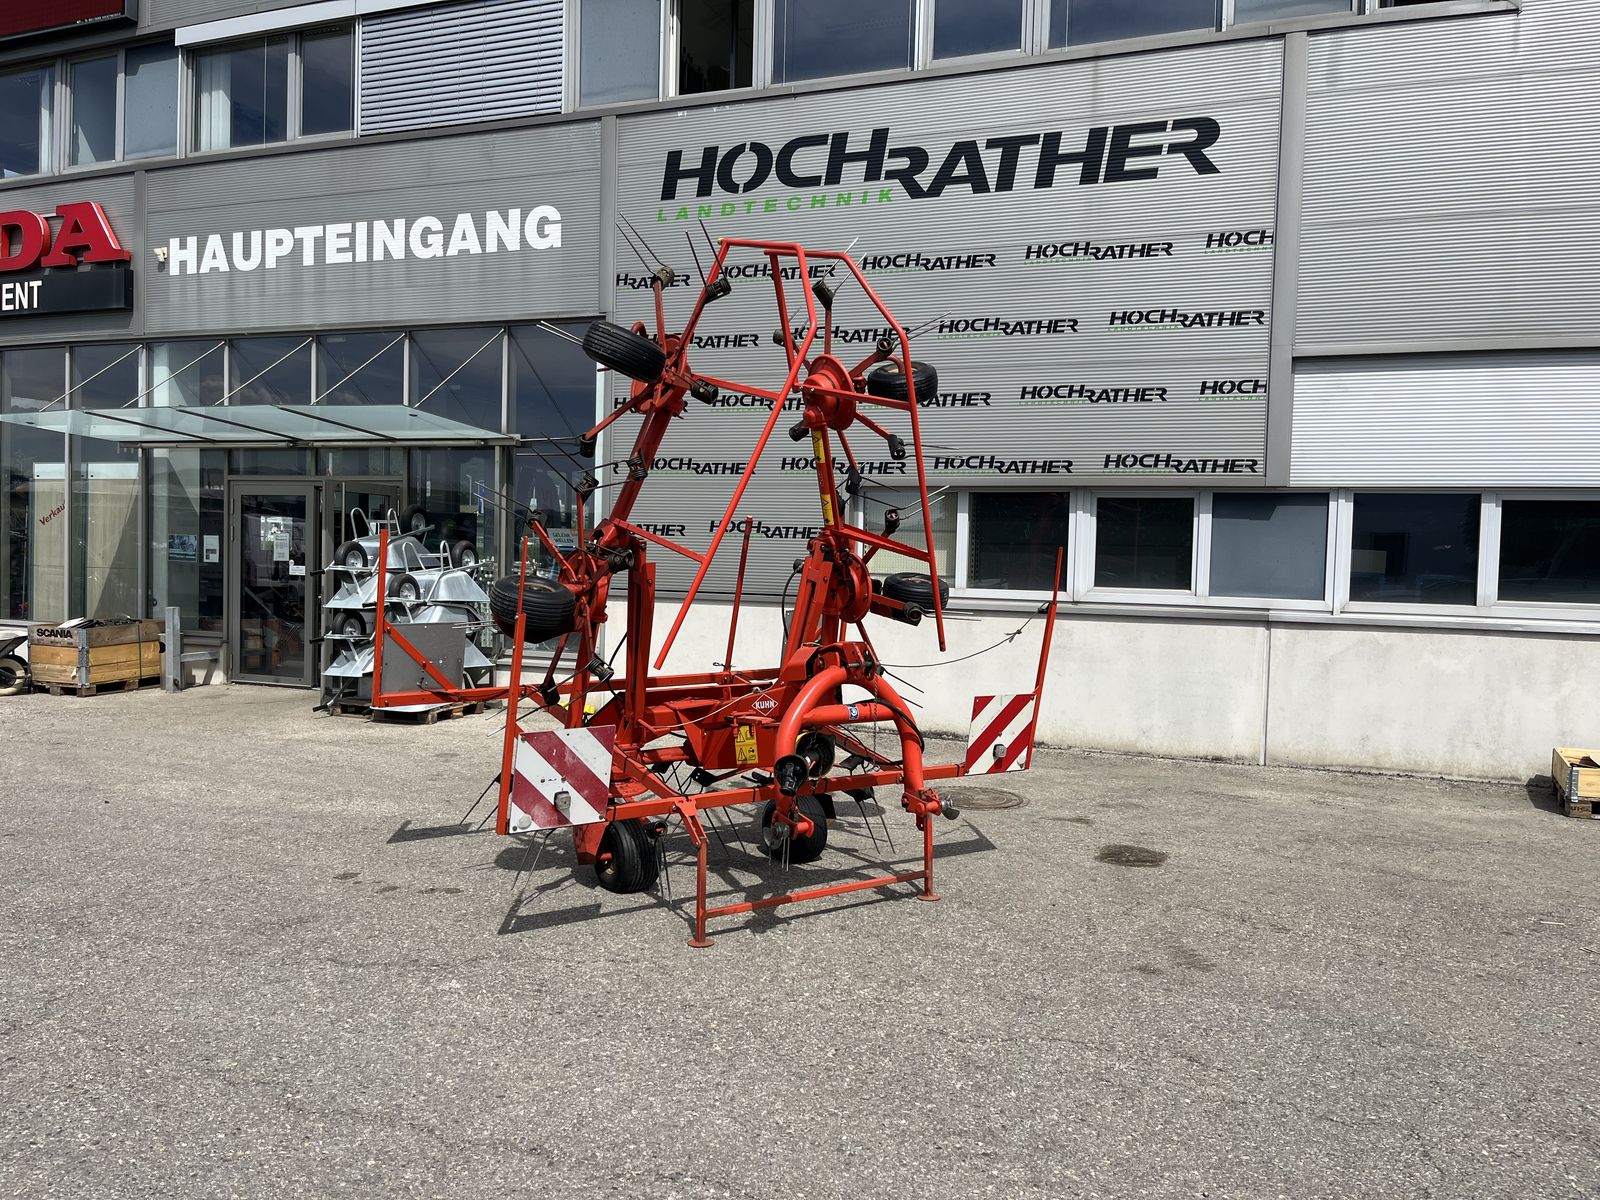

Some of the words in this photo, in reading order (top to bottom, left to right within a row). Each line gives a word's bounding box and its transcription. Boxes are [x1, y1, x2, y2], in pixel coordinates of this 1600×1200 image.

[660, 116, 1222, 201] HOCHRATHER
[657, 187, 896, 222] LANDTECHNIK
[168, 205, 563, 276] HAUPTEINGANG
[1025, 241, 1174, 260] HOCHRATHER
[862, 253, 997, 271] HOCHRATHER
[1, 280, 43, 311] ENT
[937, 316, 1079, 335] HOCHRATHER
[1110, 309, 1265, 328] HOCHRATHER
[1020, 385, 1168, 403] HOCHRATHER
[1199, 379, 1267, 395] HOCH
[933, 455, 1074, 475] HOCHRATHER
[1103, 453, 1258, 474] HOCHRATHER
[36, 628, 73, 639] SCANIA
[755, 701, 775, 709] KUHN
